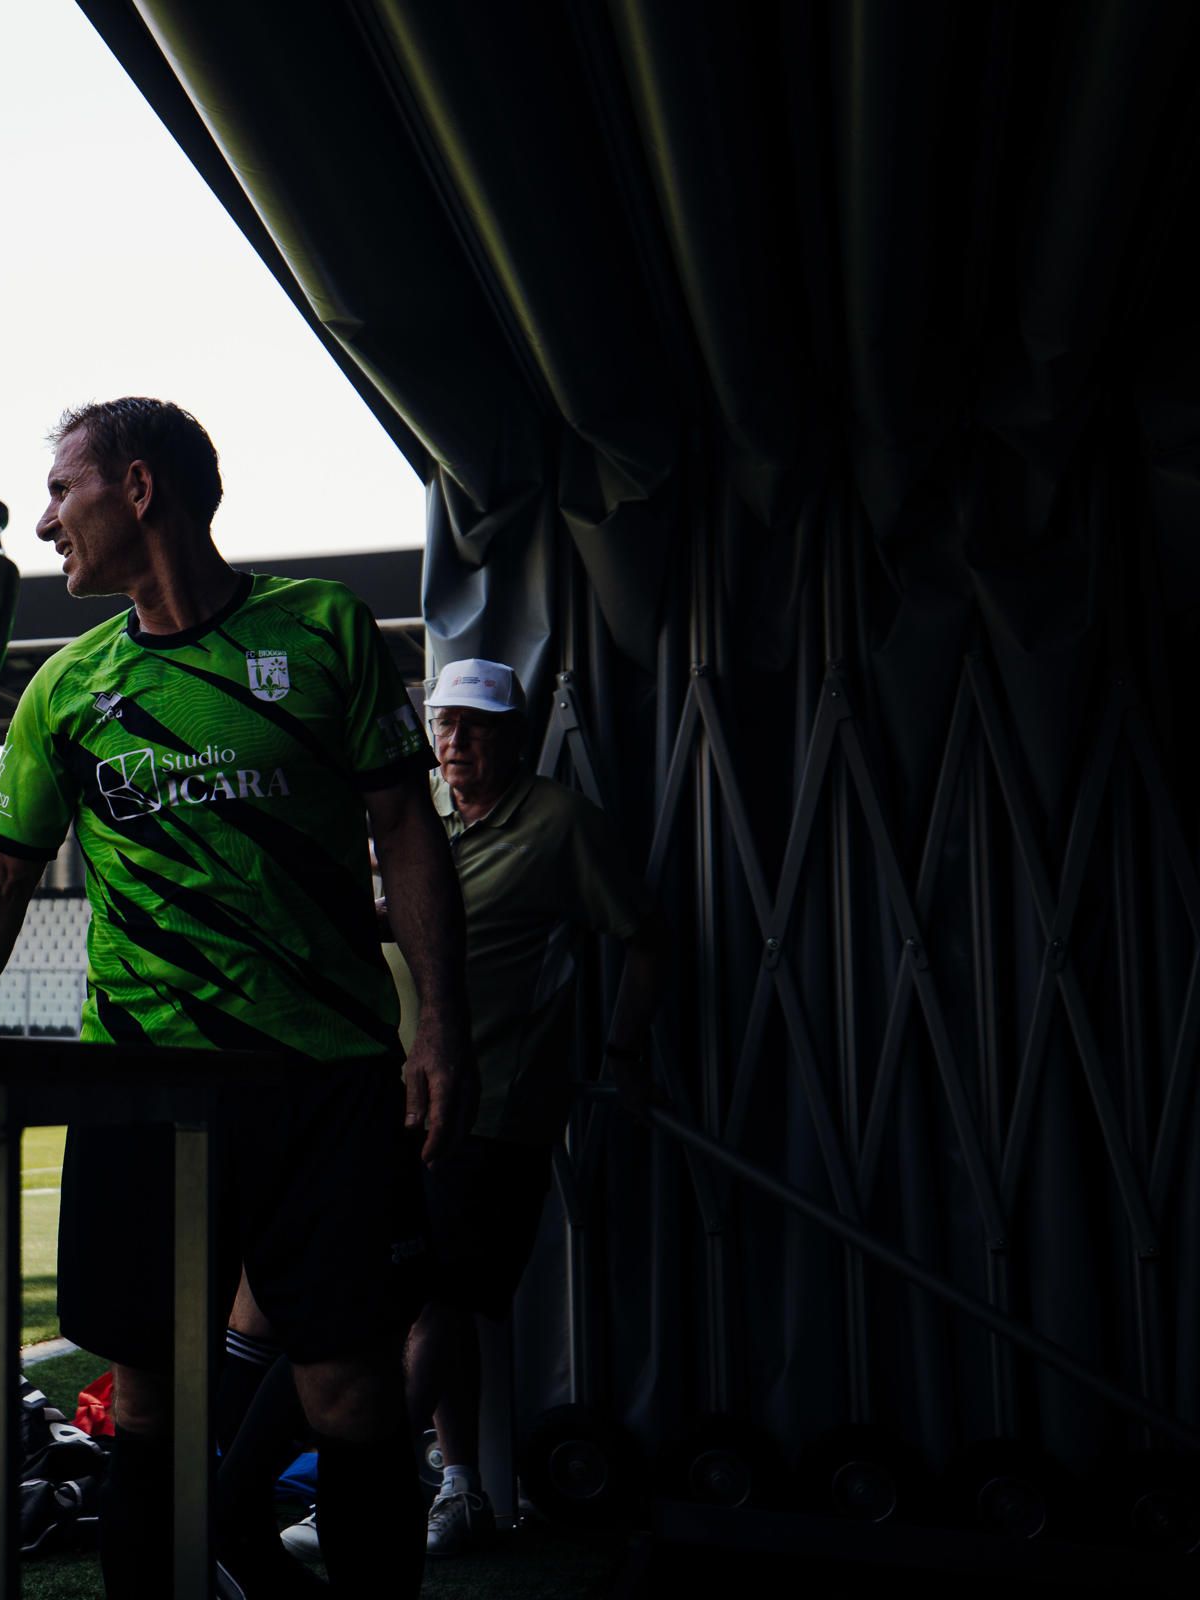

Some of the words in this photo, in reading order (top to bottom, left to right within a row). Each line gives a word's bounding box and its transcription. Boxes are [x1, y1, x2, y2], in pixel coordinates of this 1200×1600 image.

[245, 650, 256, 659] FC
[161, 744, 236, 773] Studio
[167, 767, 291, 807] ICARA
